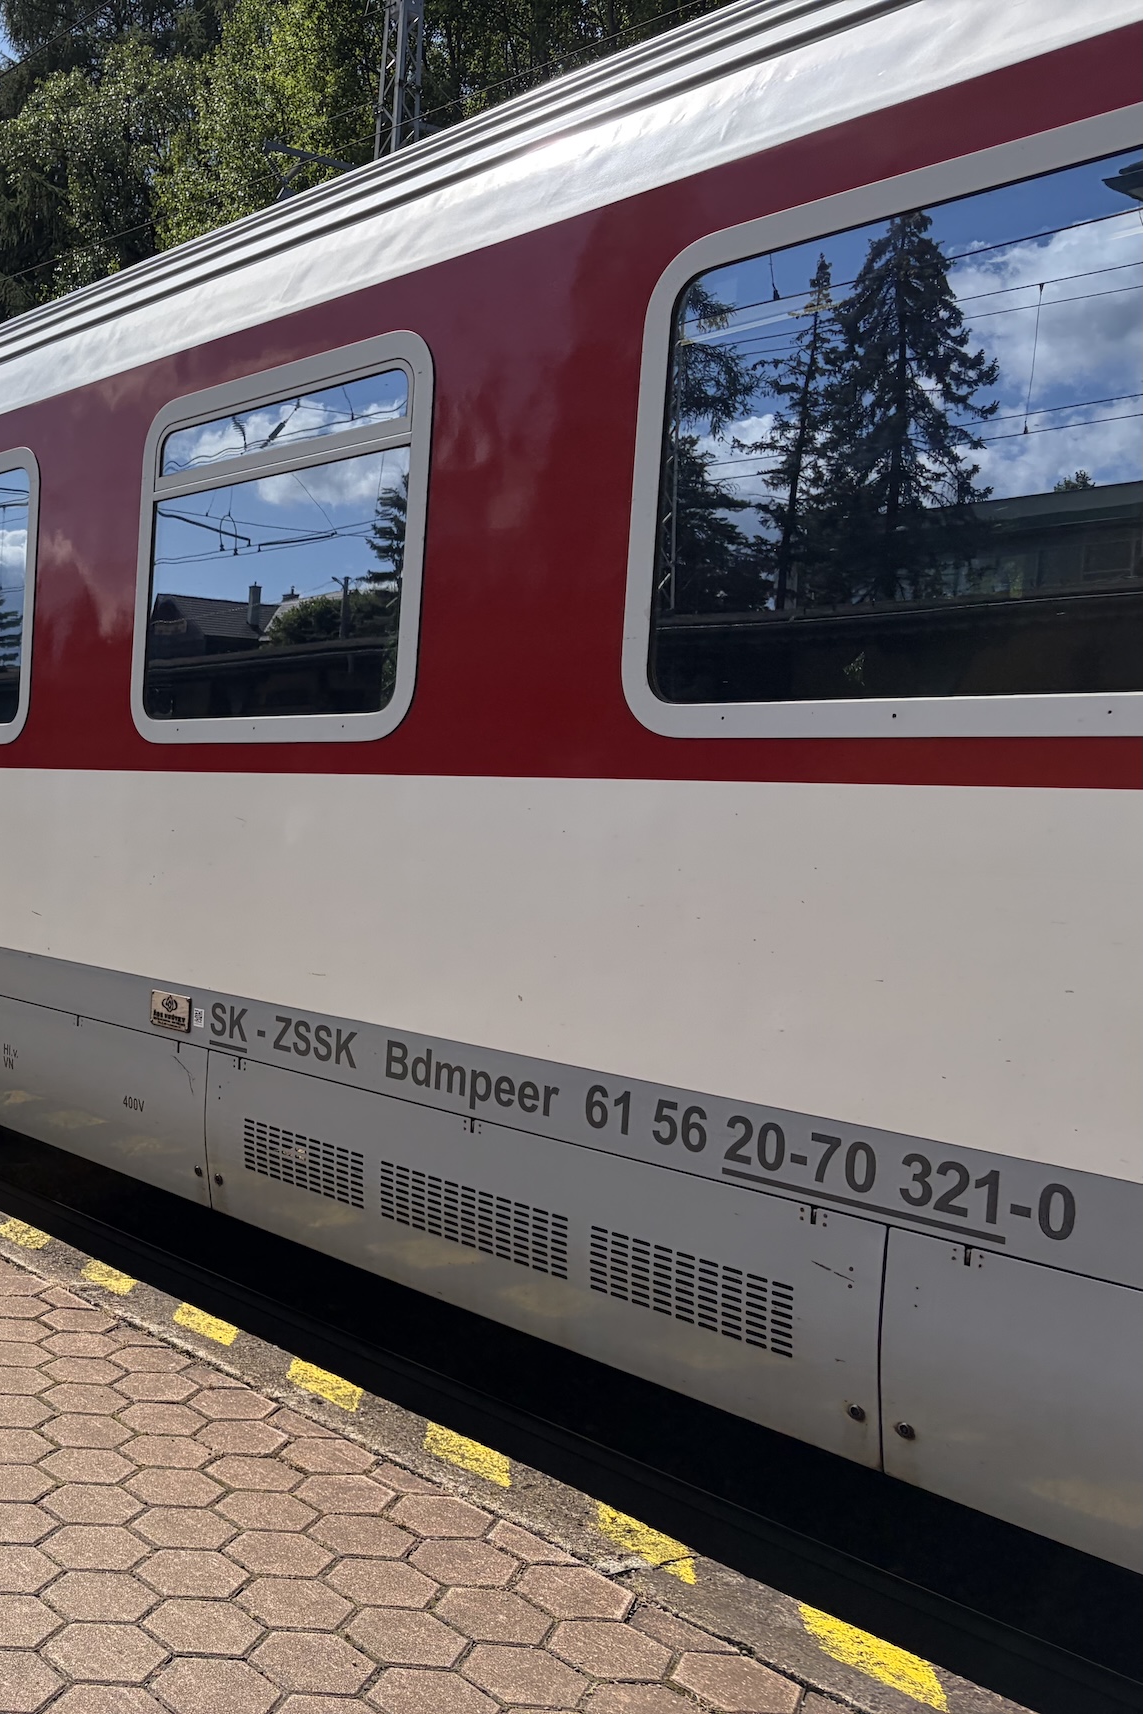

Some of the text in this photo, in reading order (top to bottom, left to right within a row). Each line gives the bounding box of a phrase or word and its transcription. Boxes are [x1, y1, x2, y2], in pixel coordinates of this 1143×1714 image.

[122, 1095, 145, 1113] 400V
[209, 1002, 248, 1043] SK
[272, 1014, 358, 1069] ZSSK
[385, 1039, 560, 1117] Bdmpeer
[584, 1084, 631, 1136] 61
[652, 1098, 707, 1153] 56
[723, 1115, 877, 1193] 20-70
[899, 1152, 1077, 1241] 321-0
